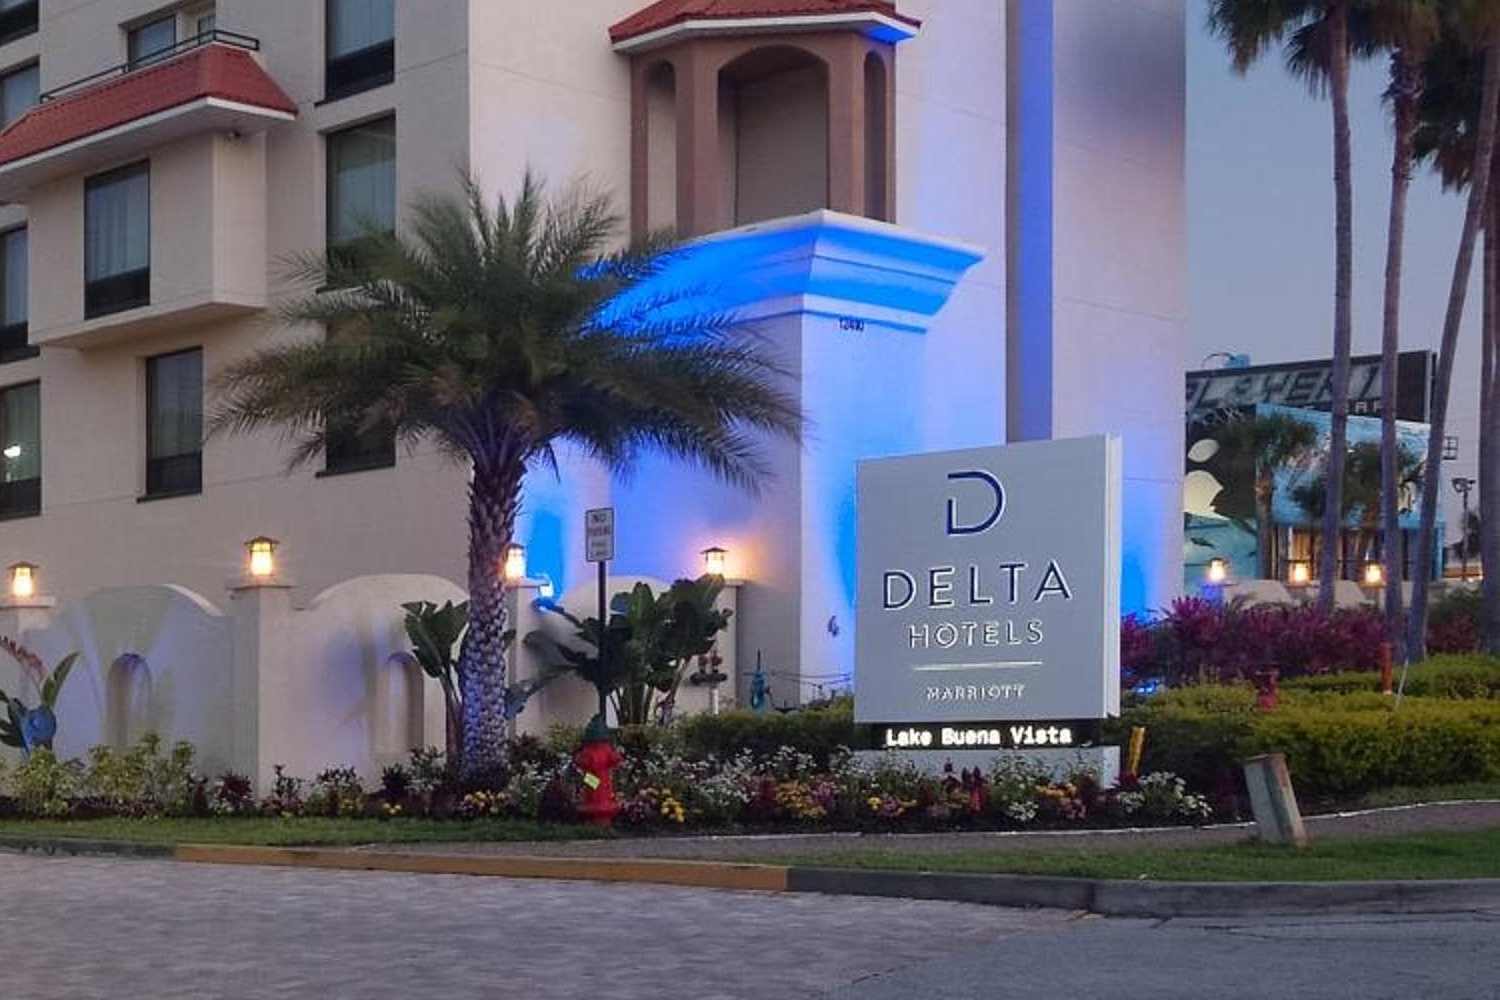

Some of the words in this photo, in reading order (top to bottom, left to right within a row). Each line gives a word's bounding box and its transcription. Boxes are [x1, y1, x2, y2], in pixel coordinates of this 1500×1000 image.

[882, 559, 1073, 611] DELTA
[909, 619, 1044, 650] HOTELS
[925, 682, 1027, 701] MARRIOTT
[885, 727, 932, 747] Lake
[941, 727, 1001, 745] Buena
[1010, 725, 1073, 745] Vista
